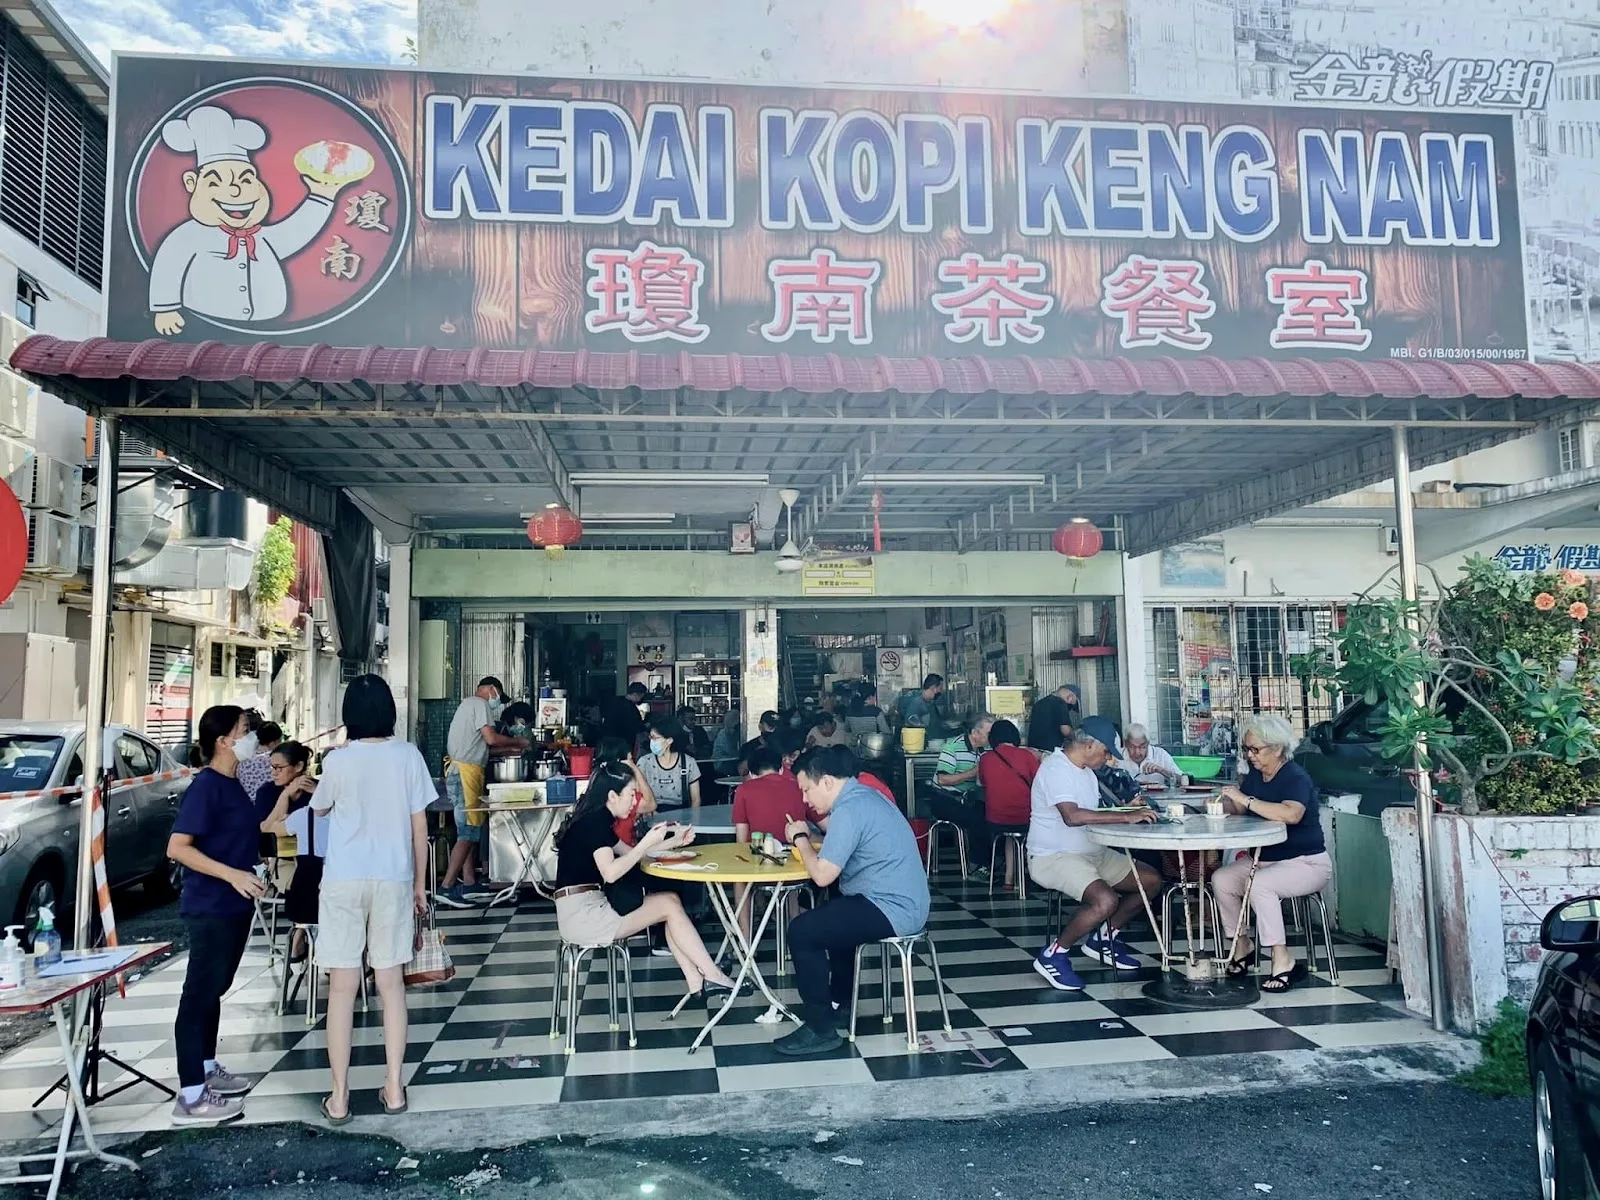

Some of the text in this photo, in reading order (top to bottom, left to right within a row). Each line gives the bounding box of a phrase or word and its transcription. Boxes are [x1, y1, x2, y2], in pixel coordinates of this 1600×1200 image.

[424, 96, 1500, 247] KEDAI KOPI KENG NAM
[585, 240, 1374, 351] 瓊南茶餐室
[1390, 347, 1526, 359] MBI. G1/B/03/015/00/1987
